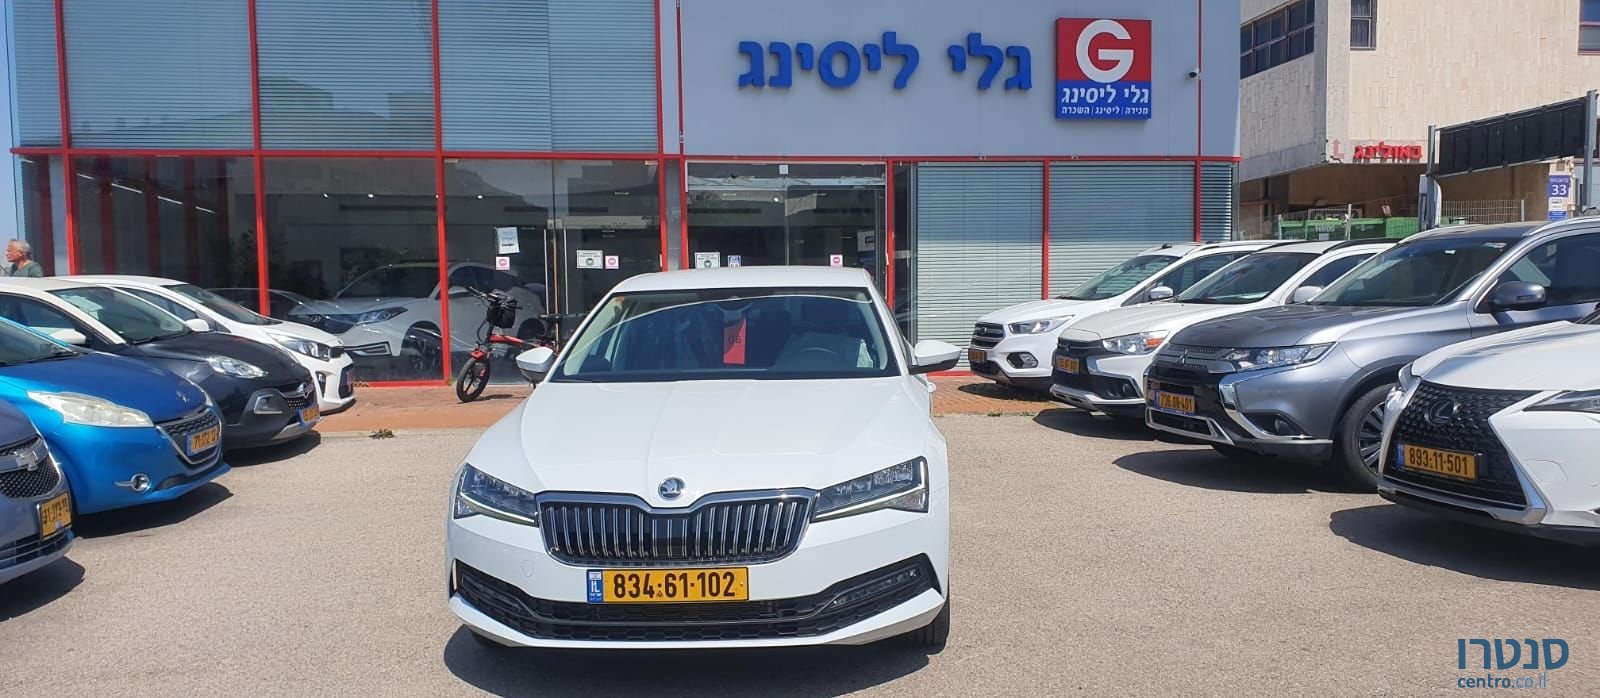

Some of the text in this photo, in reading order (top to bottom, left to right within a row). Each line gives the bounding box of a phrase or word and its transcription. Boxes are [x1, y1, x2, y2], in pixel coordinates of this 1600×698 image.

[1075, 19, 1134, 83] G
[738, 31, 1032, 90] גלי ליסינג
[1061, 84, 1149, 103] גלי ליסינג
[1061, 105, 1149, 115] מכירה ליסינג השכרה
[1354, 141, 1423, 159] באולינג
[1551, 184, 1567, 196] 33
